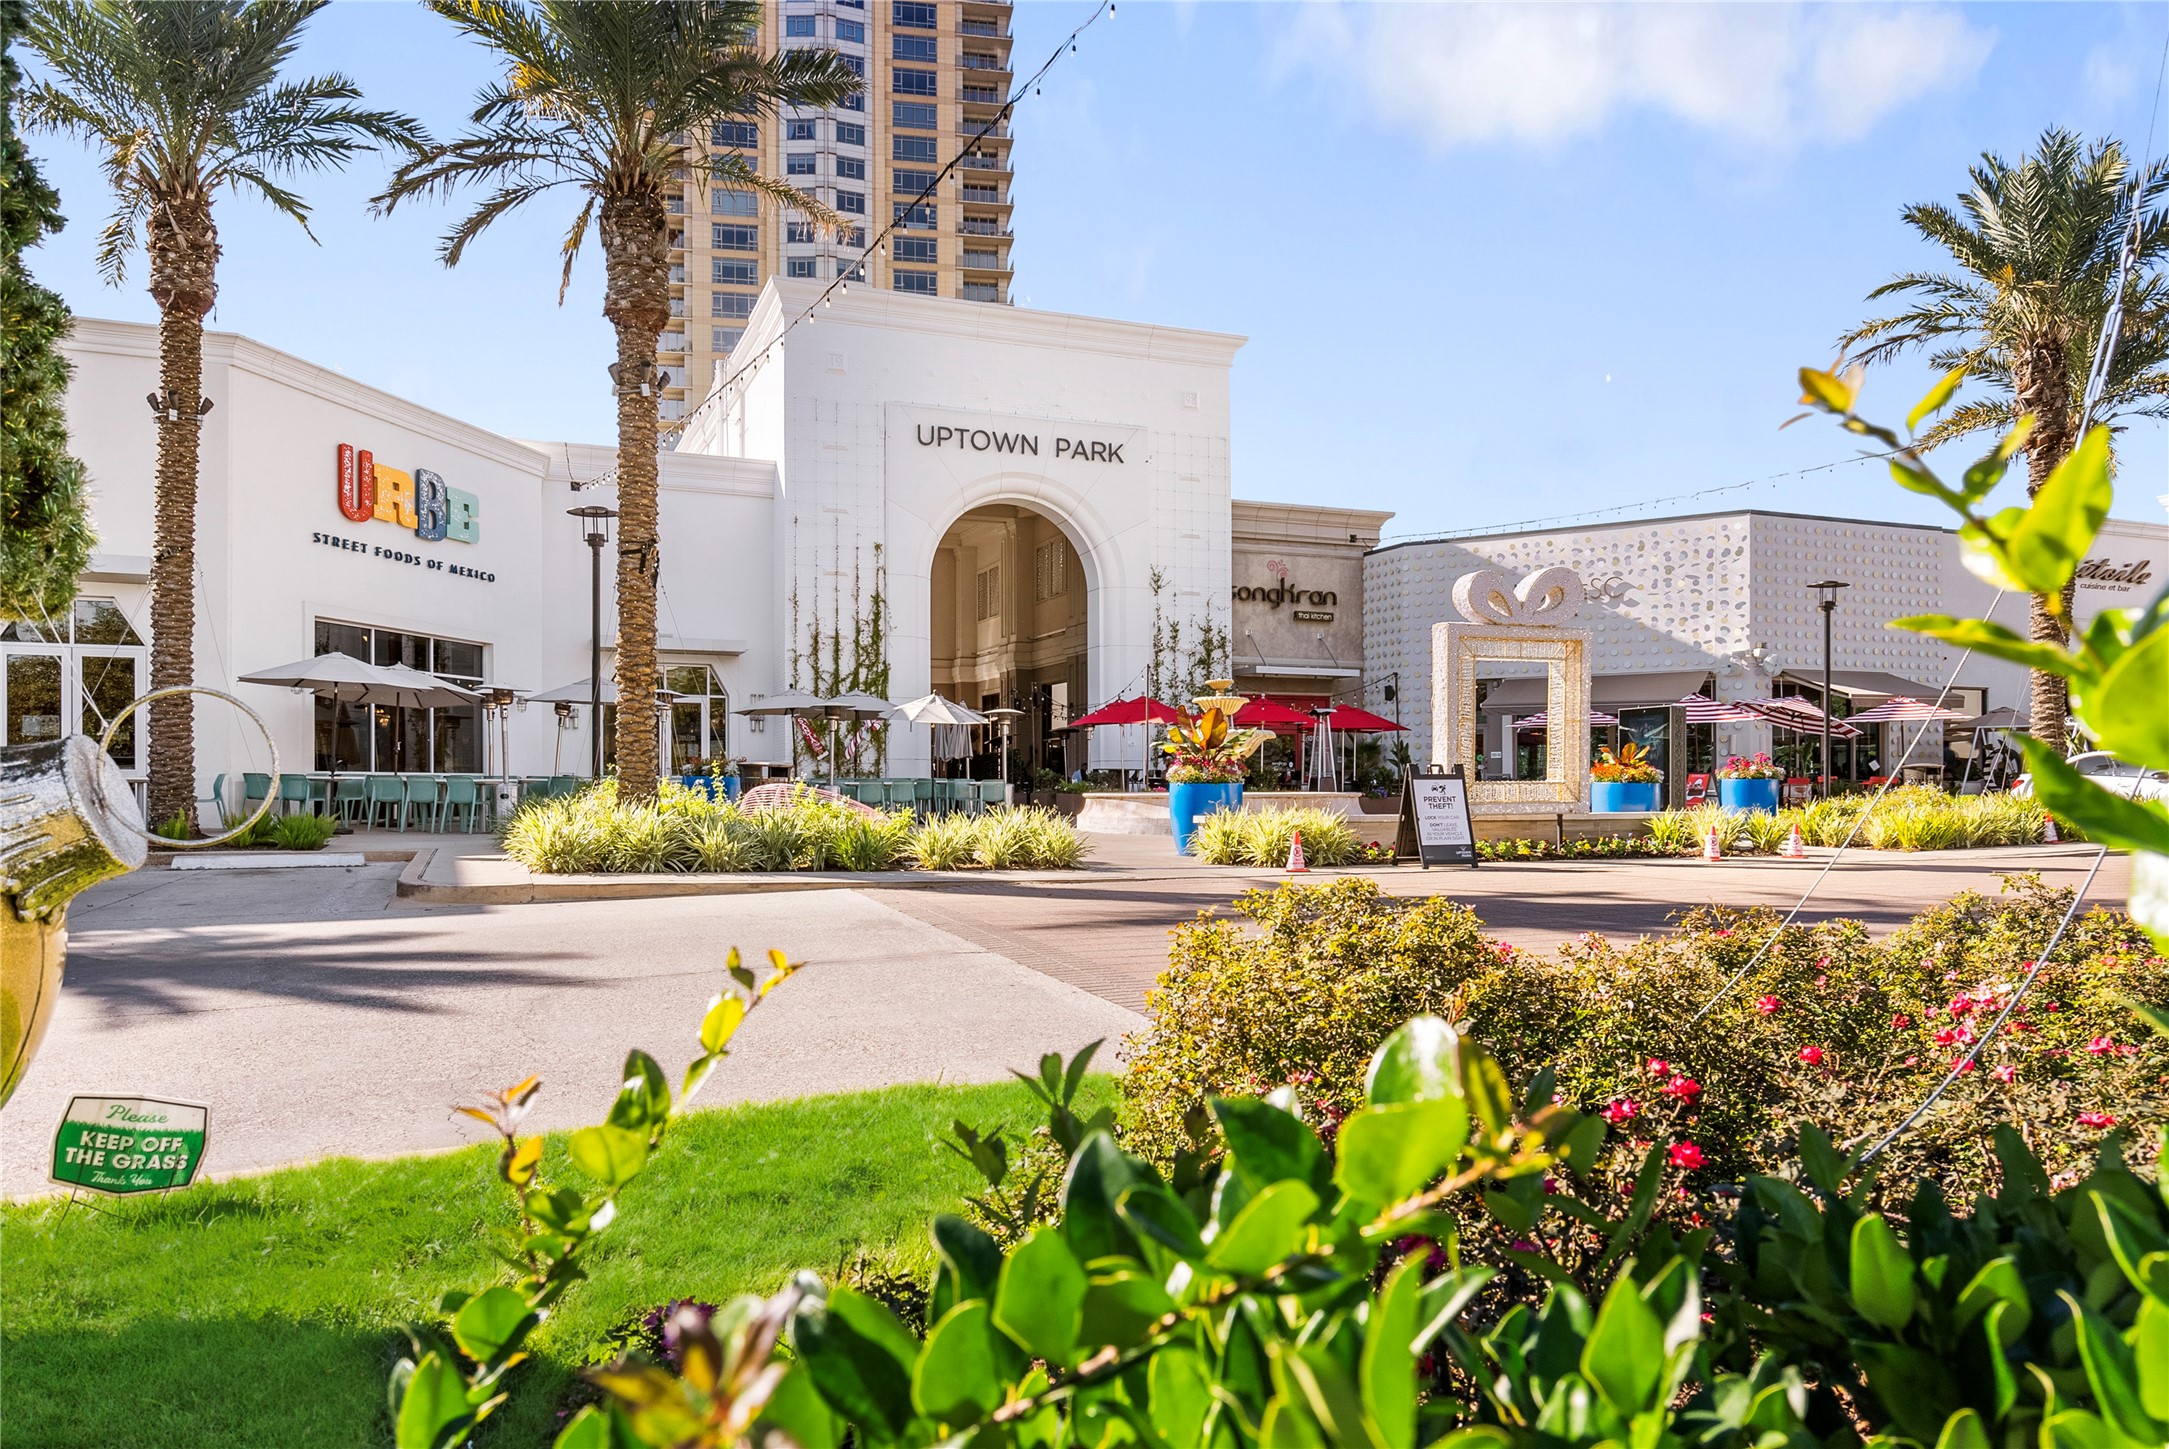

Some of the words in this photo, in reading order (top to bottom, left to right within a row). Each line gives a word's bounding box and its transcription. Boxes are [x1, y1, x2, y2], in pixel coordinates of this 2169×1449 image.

[917, 424, 1038, 456] UPTOWN
[1056, 437, 1124, 464] PARK
[337, 443, 480, 544] URBE
[313, 532, 368, 553] STREET
[374, 547, 421, 566] FOODS
[427, 559, 444, 570] OF
[448, 563, 495, 583] MEXICO
[2080, 582, 2106, 591] cuisine
[2117, 584, 2131, 592] bar
[1310, 612, 1333, 620] kitchen
[106, 1104, 170, 1124] Please
[79, 1130, 134, 1151] KEEP
[141, 1136, 184, 1153] OFF
[65, 1147, 106, 1167] THE
[112, 1153, 189, 1170] GRASS
[90, 1170, 126, 1185] Thank
[130, 1173, 153, 1187] You
